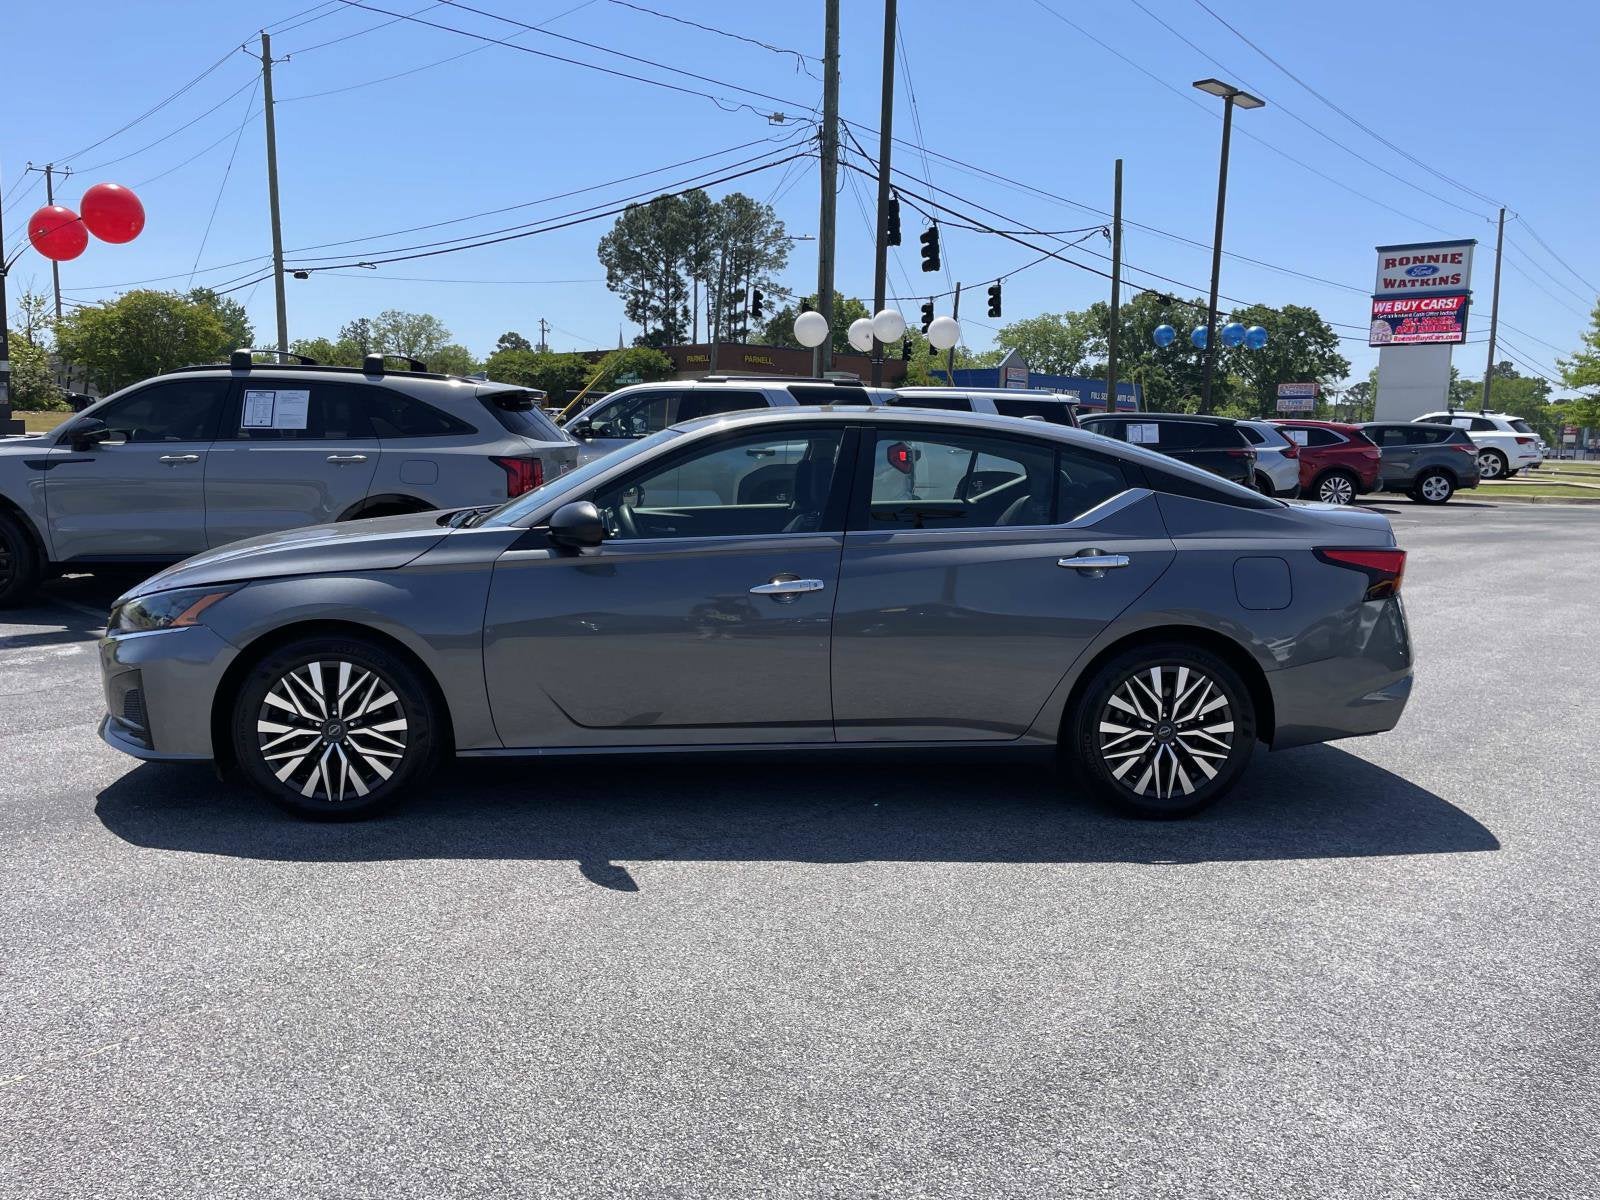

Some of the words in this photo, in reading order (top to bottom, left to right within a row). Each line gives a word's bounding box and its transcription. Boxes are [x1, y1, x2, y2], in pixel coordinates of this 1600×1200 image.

[1384, 253, 1463, 270] RONNIE
[1411, 266, 1433, 276] Ford
[1383, 273, 1462, 289] WATKINS
[1373, 302, 1393, 313] WE
[1394, 301, 1419, 311] BUY
[1420, 298, 1458, 310] CARS!
[744, 355, 774, 364] PARNELL
